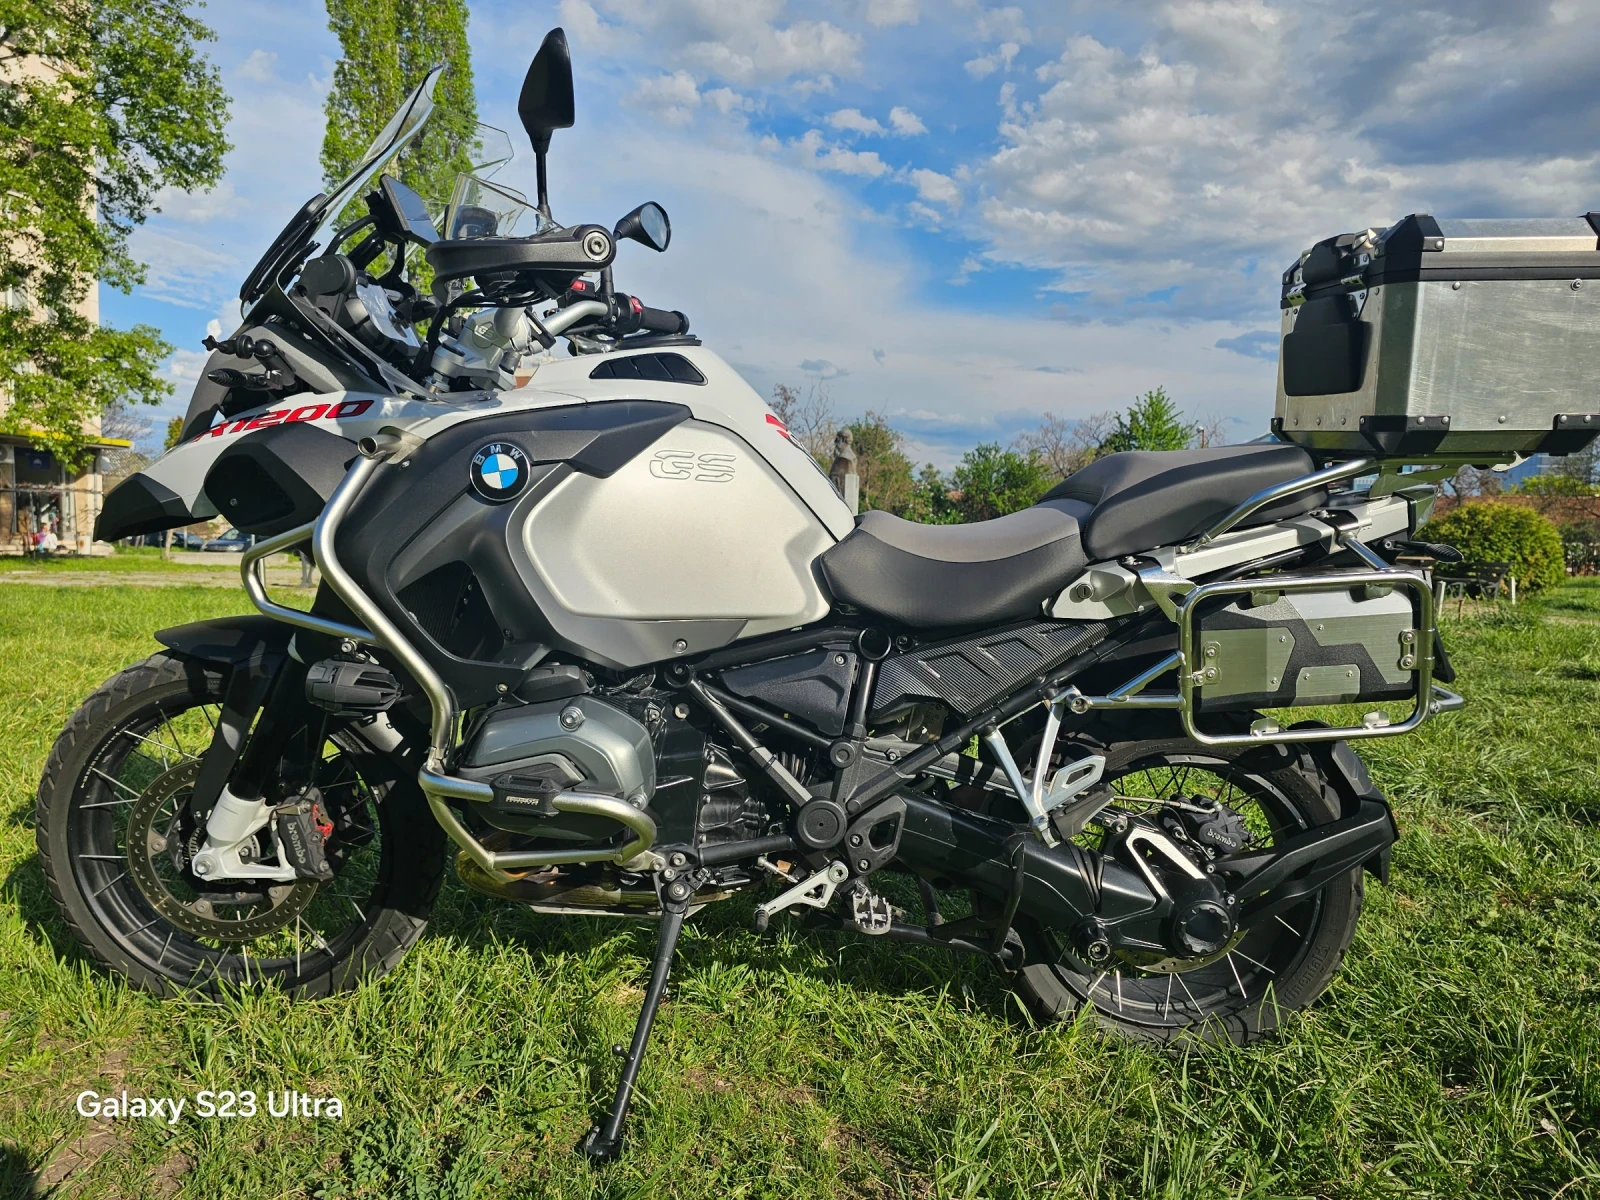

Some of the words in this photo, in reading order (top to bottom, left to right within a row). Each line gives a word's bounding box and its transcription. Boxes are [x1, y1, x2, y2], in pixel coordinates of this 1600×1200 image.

[193, 400, 375, 442] R1200
[474, 444, 522, 466] BMW
[649, 449, 737, 483] GS
[287, 822, 306, 864] brembo
[1207, 828, 1237, 848] brembo
